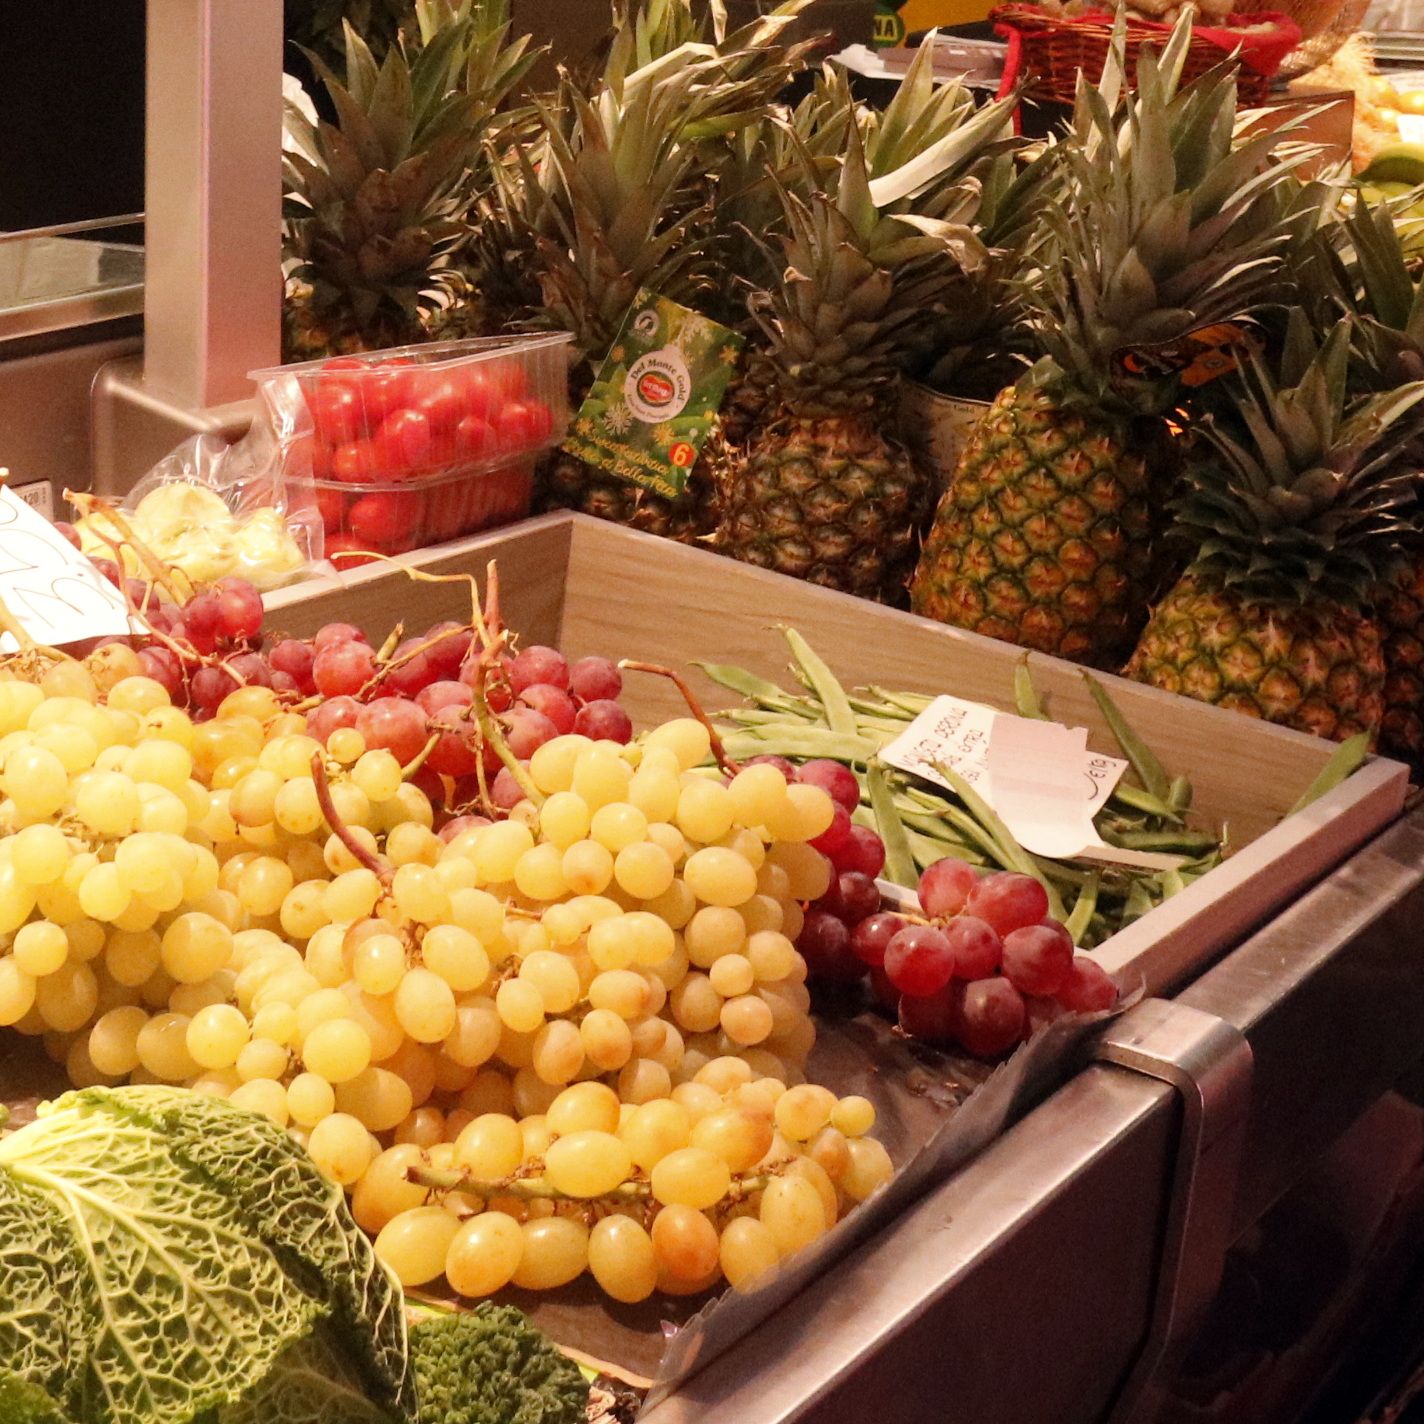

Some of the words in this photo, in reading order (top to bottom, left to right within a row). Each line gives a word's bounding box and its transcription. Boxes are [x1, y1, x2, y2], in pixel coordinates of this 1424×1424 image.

[631, 361, 647, 381] Del
[647, 357, 677, 375] Monte
[677, 375, 687, 403] Gold
[673, 445, 690, 467] 6
